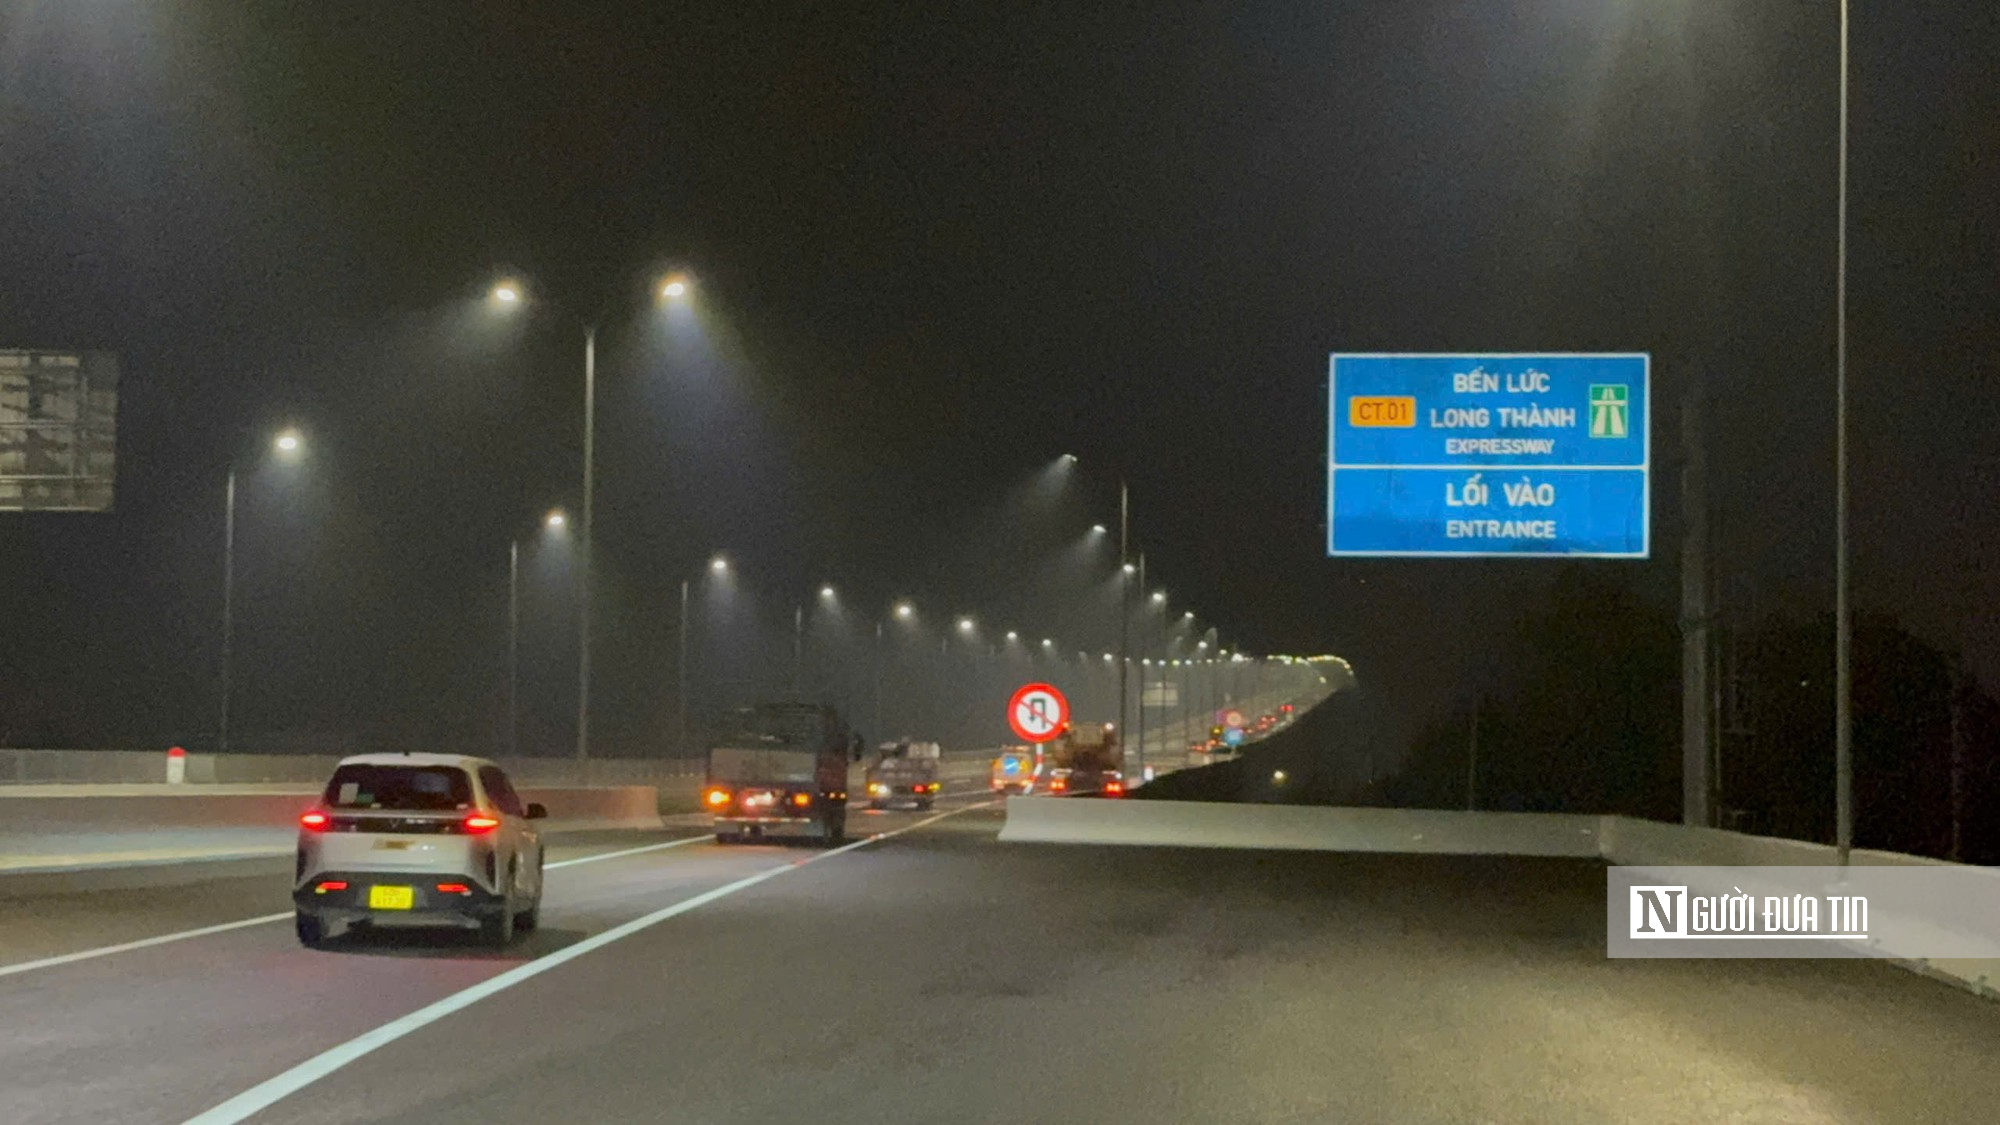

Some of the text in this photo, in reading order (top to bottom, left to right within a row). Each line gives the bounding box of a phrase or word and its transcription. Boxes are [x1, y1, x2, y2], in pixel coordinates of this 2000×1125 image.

[1453, 366, 1550, 393] BẾN LỨC
[1358, 402, 1408, 421] CT.01
[1430, 403, 1576, 428] LONG THÀNH
[1445, 438, 1555, 455] EXPRESSWAY
[1446, 474, 1555, 507] LỐI VÀO
[1446, 520, 1556, 539] ENTRANCE
